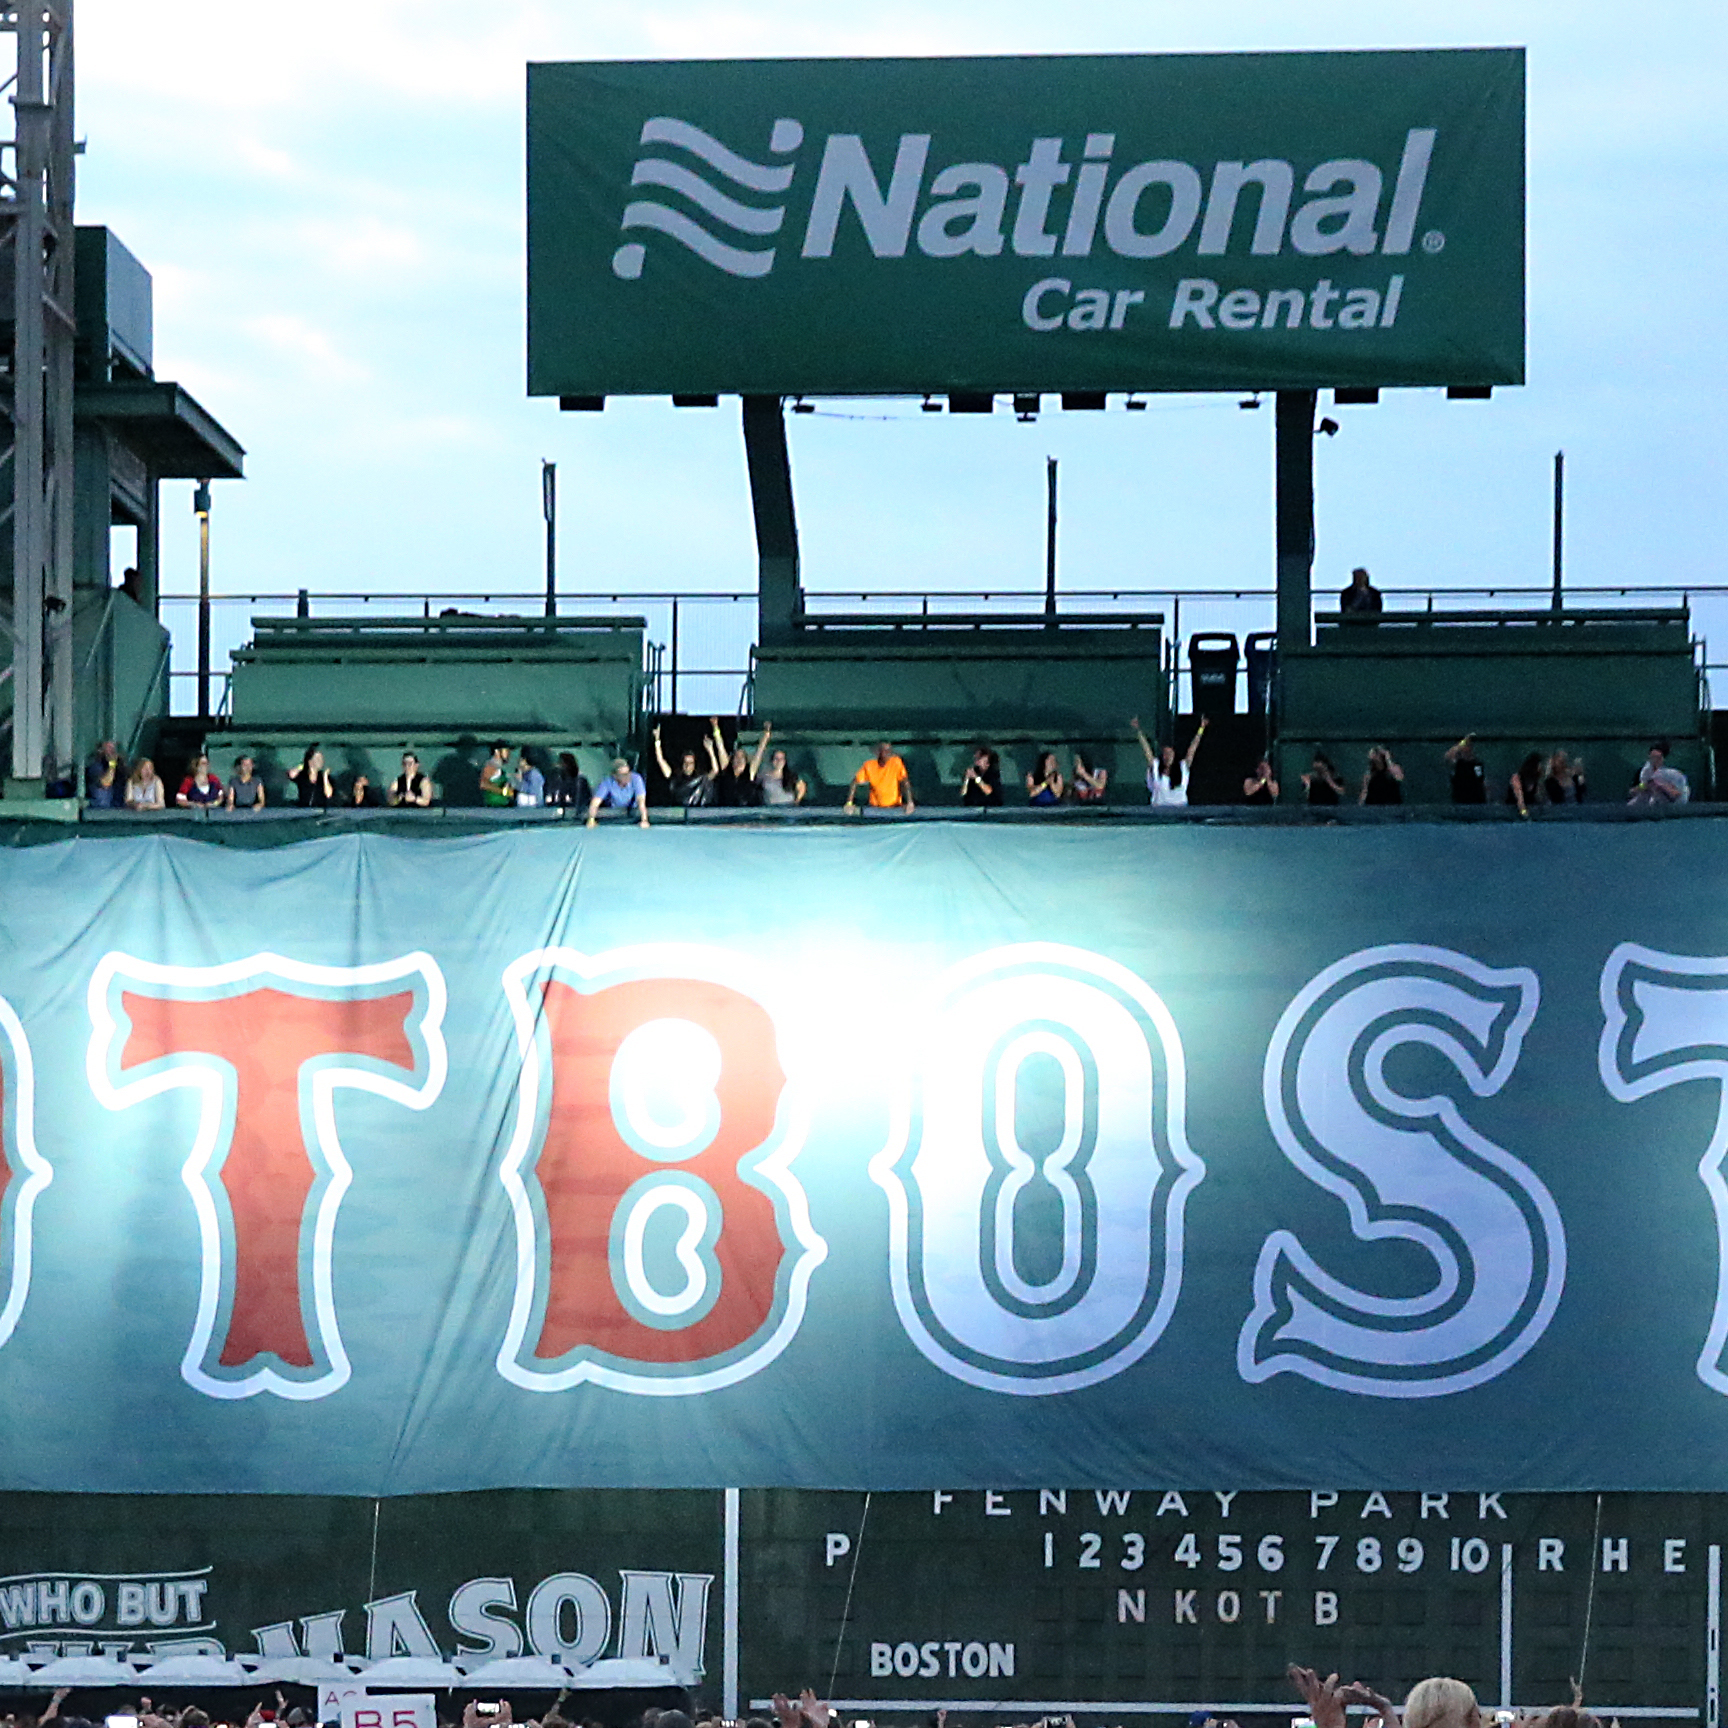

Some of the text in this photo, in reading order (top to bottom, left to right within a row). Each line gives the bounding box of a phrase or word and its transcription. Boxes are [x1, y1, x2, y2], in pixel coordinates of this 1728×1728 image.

[801, 127, 1437, 259] National
[1021, 274, 1405, 331] Car Rental
[932, 1489, 1508, 1520] FENWAY PARK
[825, 1532, 851, 1567] P
[116, 1578, 208, 1627] BUT
[869, 1641, 1016, 1679] BOSTON
[324, 1690, 358, 1707] A
